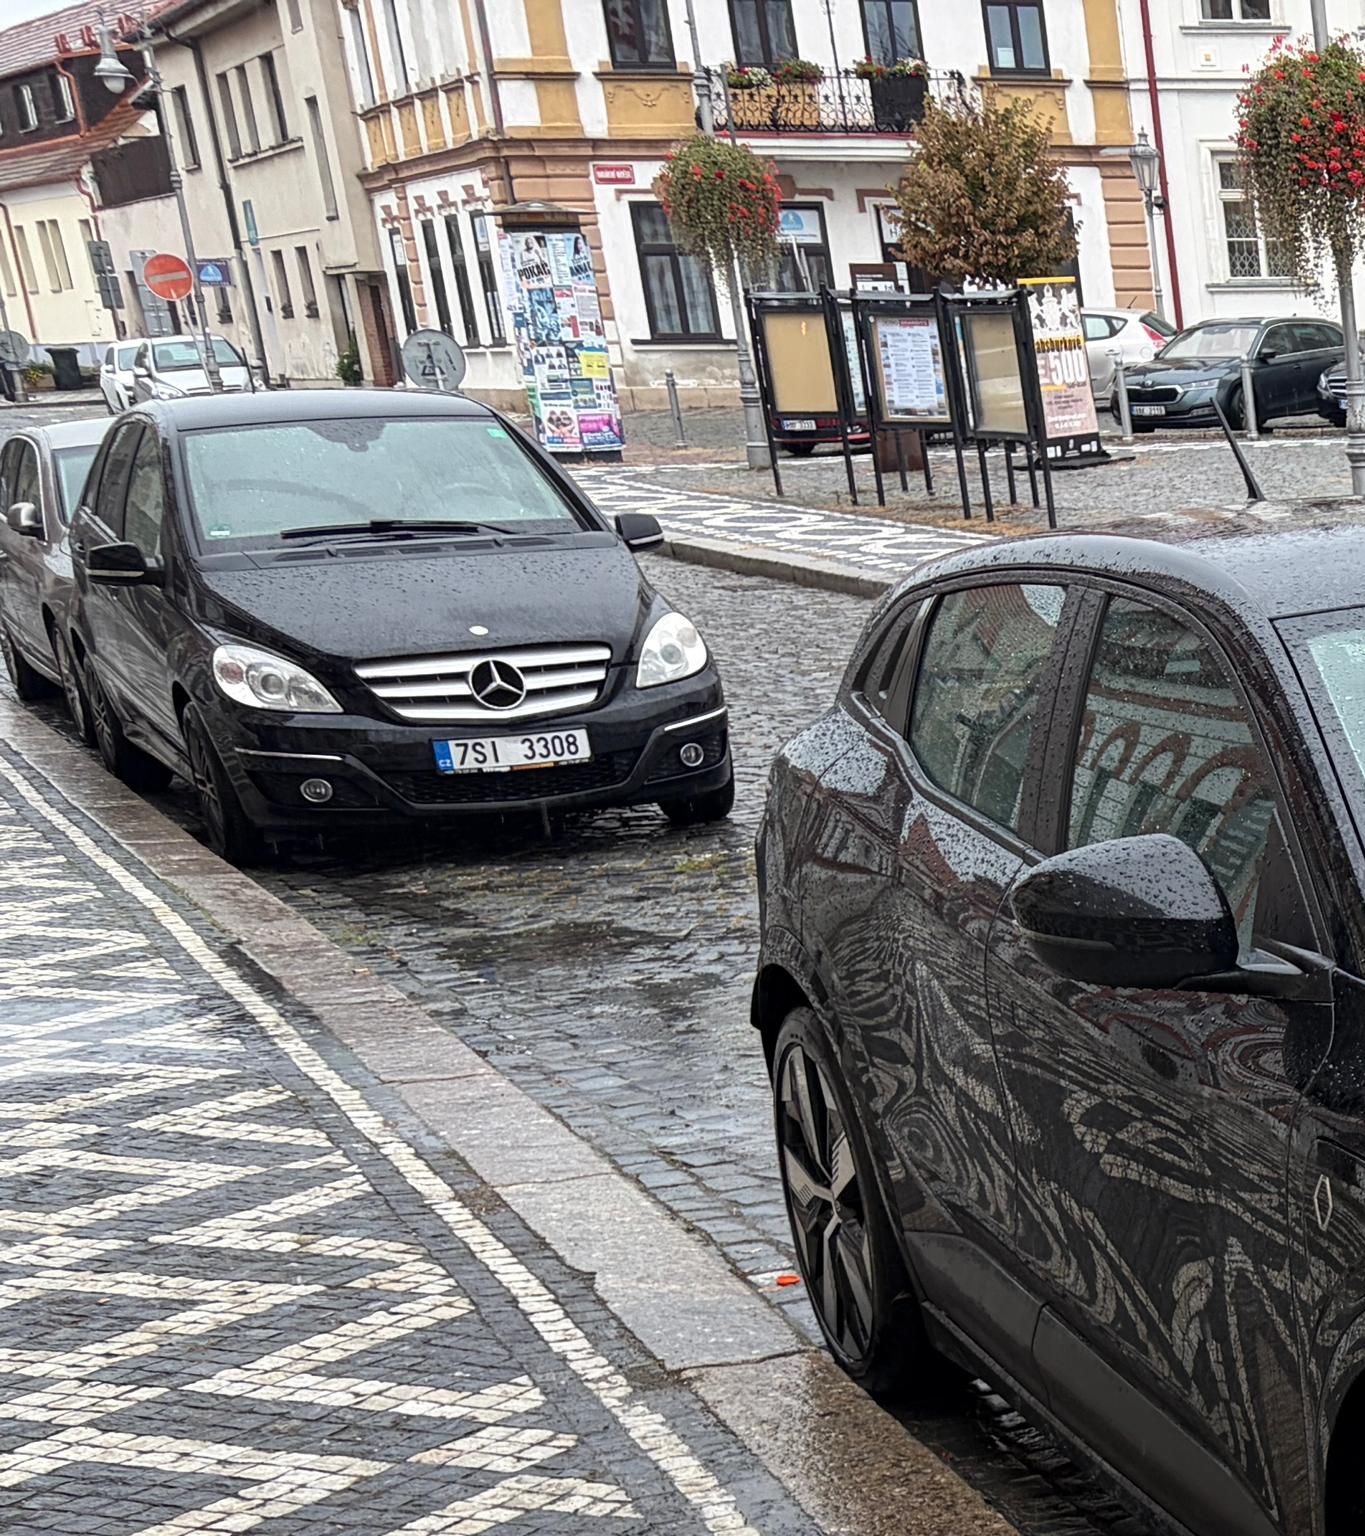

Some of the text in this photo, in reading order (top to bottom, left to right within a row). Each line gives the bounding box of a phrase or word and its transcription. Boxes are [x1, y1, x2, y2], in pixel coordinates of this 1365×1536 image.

[1035, 334, 1082, 354] absburkové
[1048, 348, 1086, 385] 500
[521, 733, 579, 760] 3308
[438, 759, 451, 768] CZ
